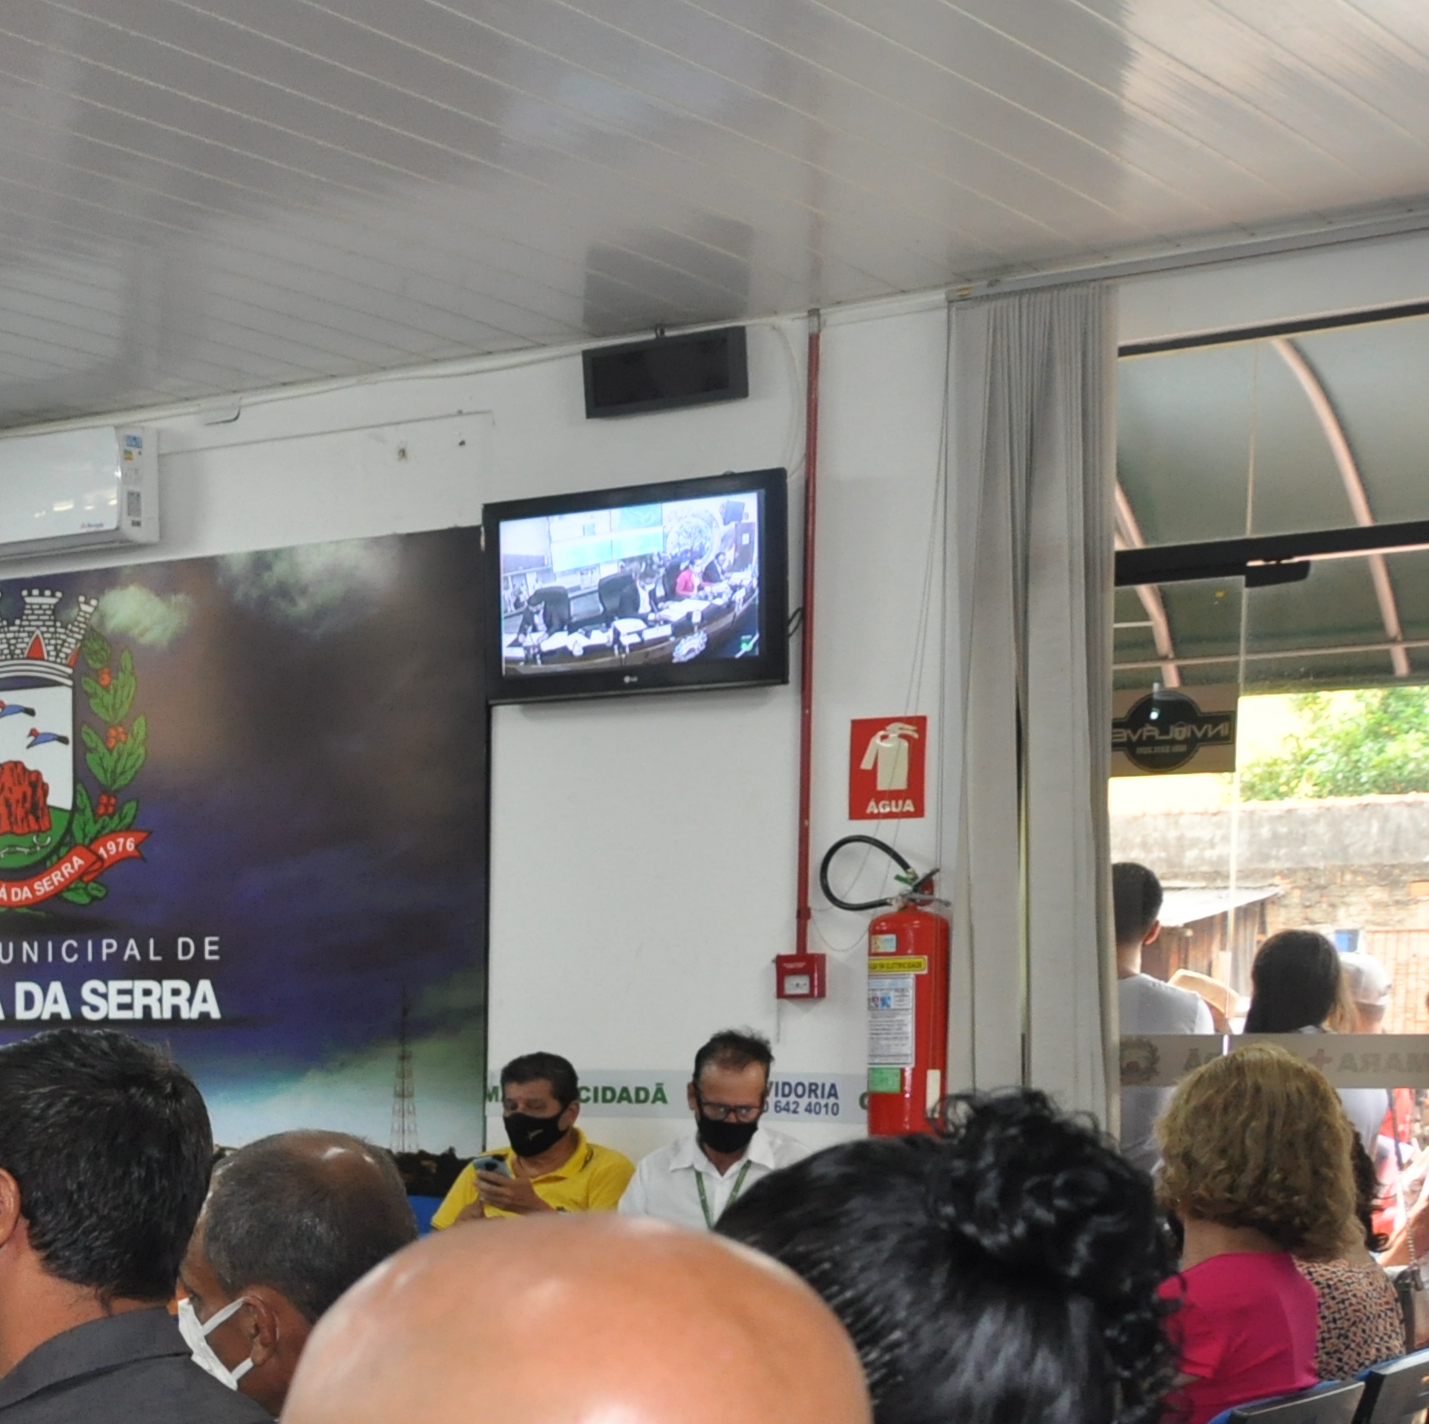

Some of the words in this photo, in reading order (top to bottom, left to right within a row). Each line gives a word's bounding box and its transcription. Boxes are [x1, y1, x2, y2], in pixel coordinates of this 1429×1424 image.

[865, 798, 915, 814] ÁGUA
[98, 837, 135, 859] 1976
[11, 887, 32, 901] DA
[34, 855, 85, 896] SERRA
[177, 936, 221, 961] DE
[15, 981, 72, 1020] DA
[81, 979, 222, 1020] SERRA
[578, 1082, 668, 1104] CIDADÃ
[774, 1100, 799, 1114] 642
[804, 1101, 839, 1116] 4010
